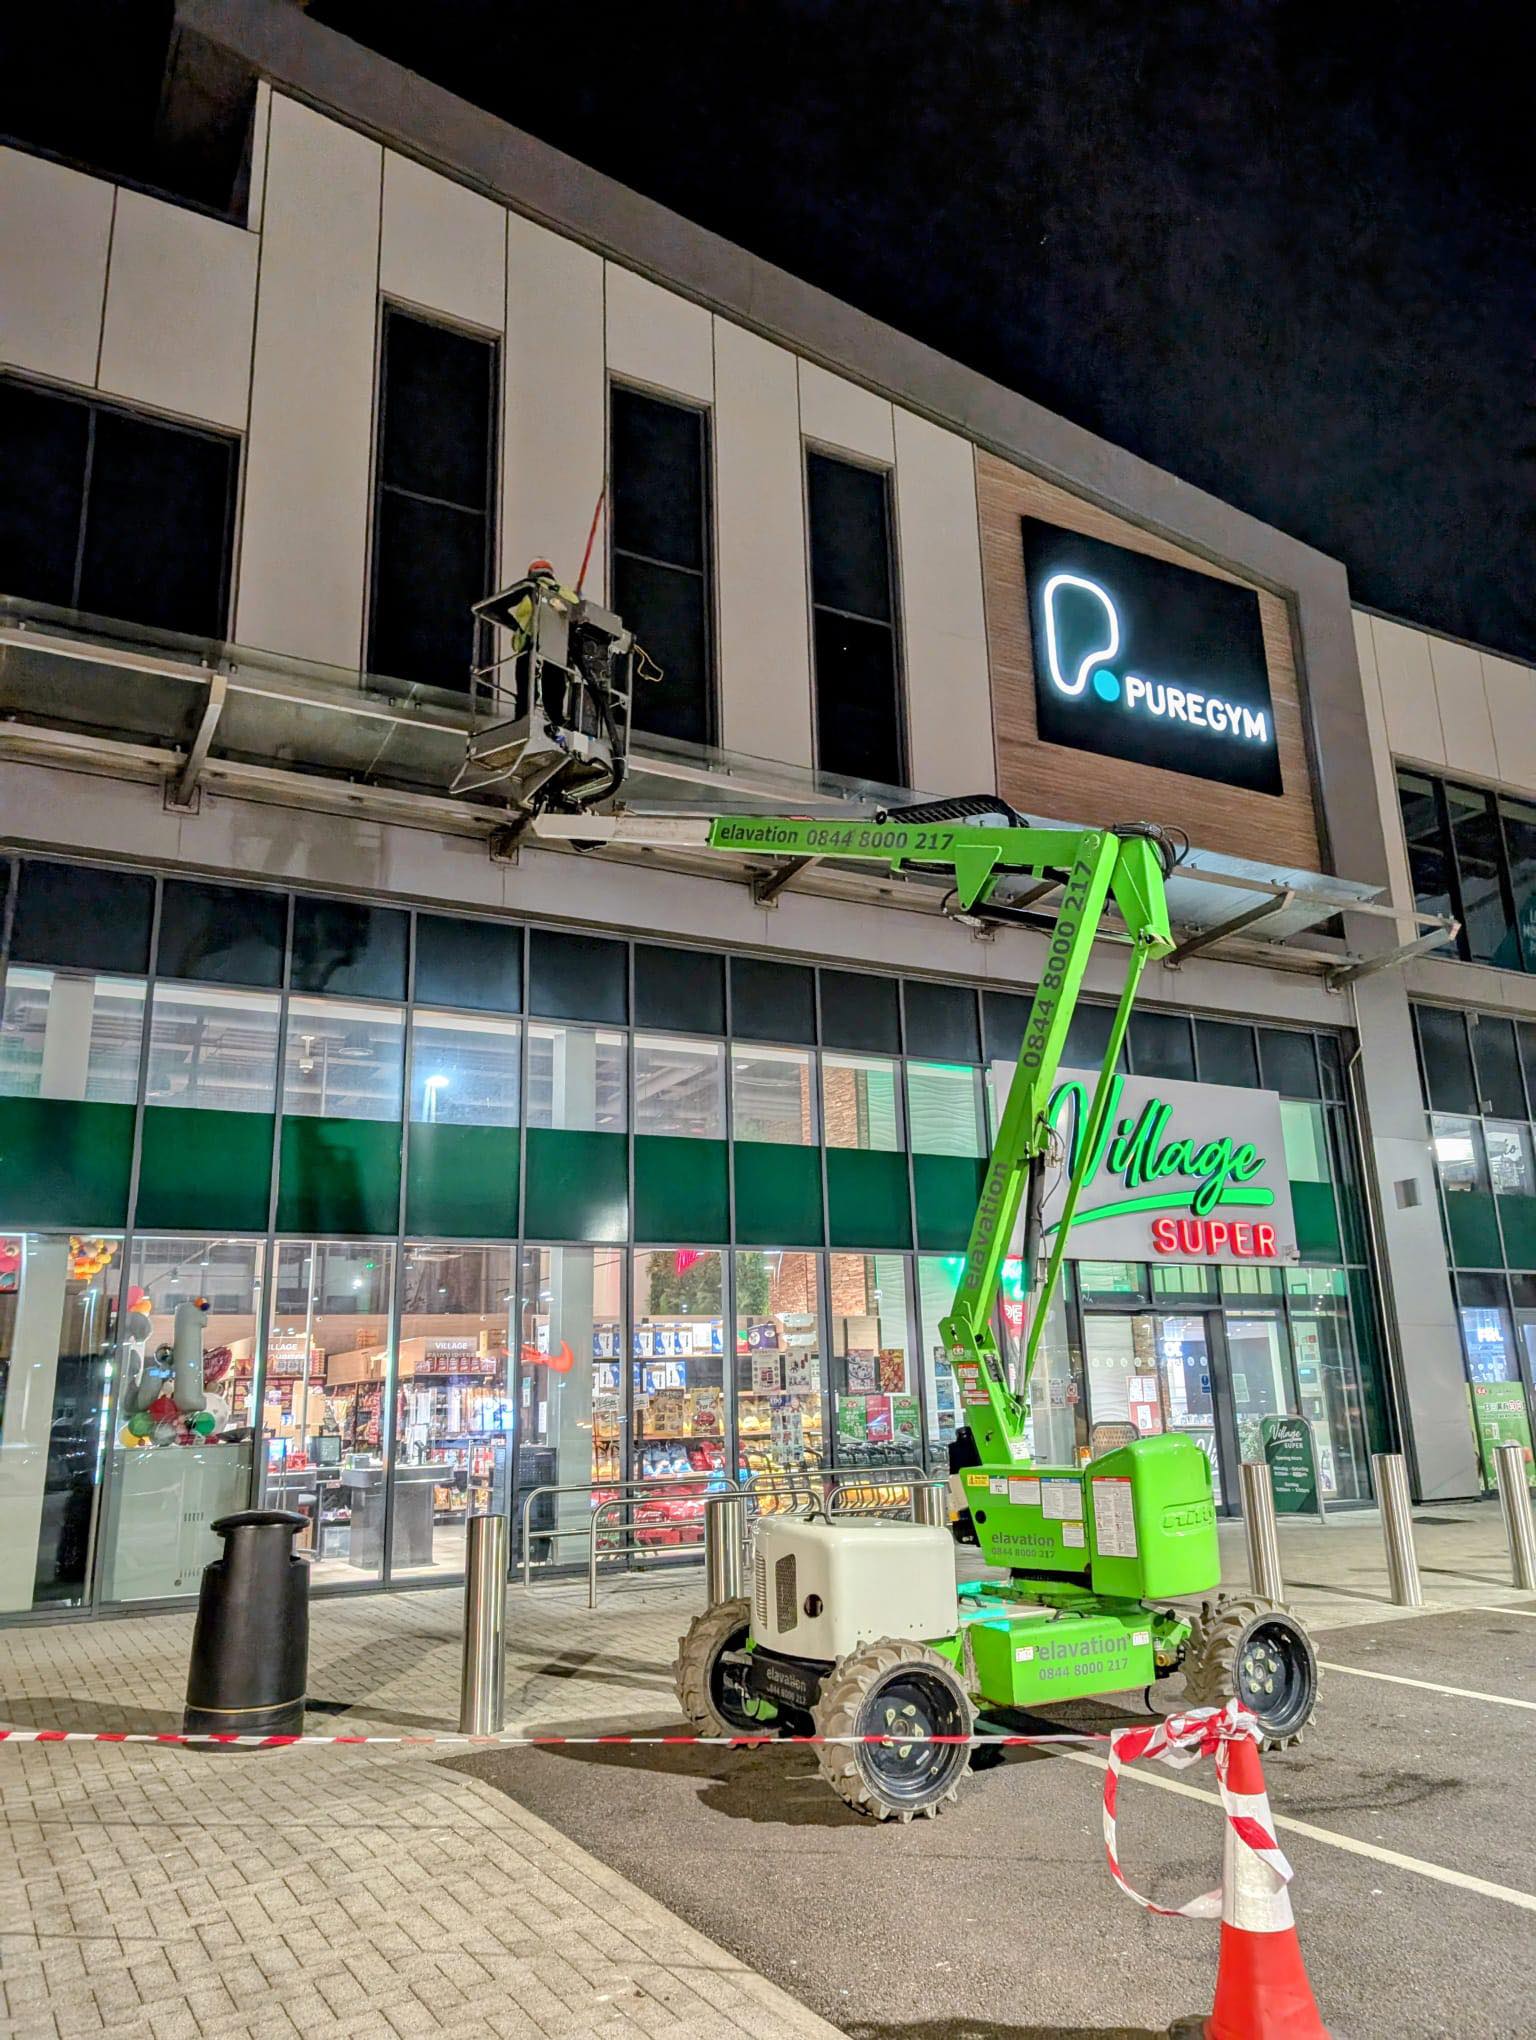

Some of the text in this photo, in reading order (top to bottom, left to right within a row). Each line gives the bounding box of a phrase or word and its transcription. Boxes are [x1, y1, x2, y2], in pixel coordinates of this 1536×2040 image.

[1125, 675, 1267, 743] PUREGYM
[720, 823, 954, 850] elavation 0844 8000 217
[965, 860, 1092, 1291] elavation 0844 8000 217
[1048, 1073, 1266, 1216] Village
[1152, 1217, 1278, 1257] SUPER
[1269, 1422, 1302, 1441] Village
[991, 1531, 1055, 1546] elavation
[1038, 1634, 1128, 1661] elavation
[1039, 1658, 1128, 1681] 0844 8000 217
